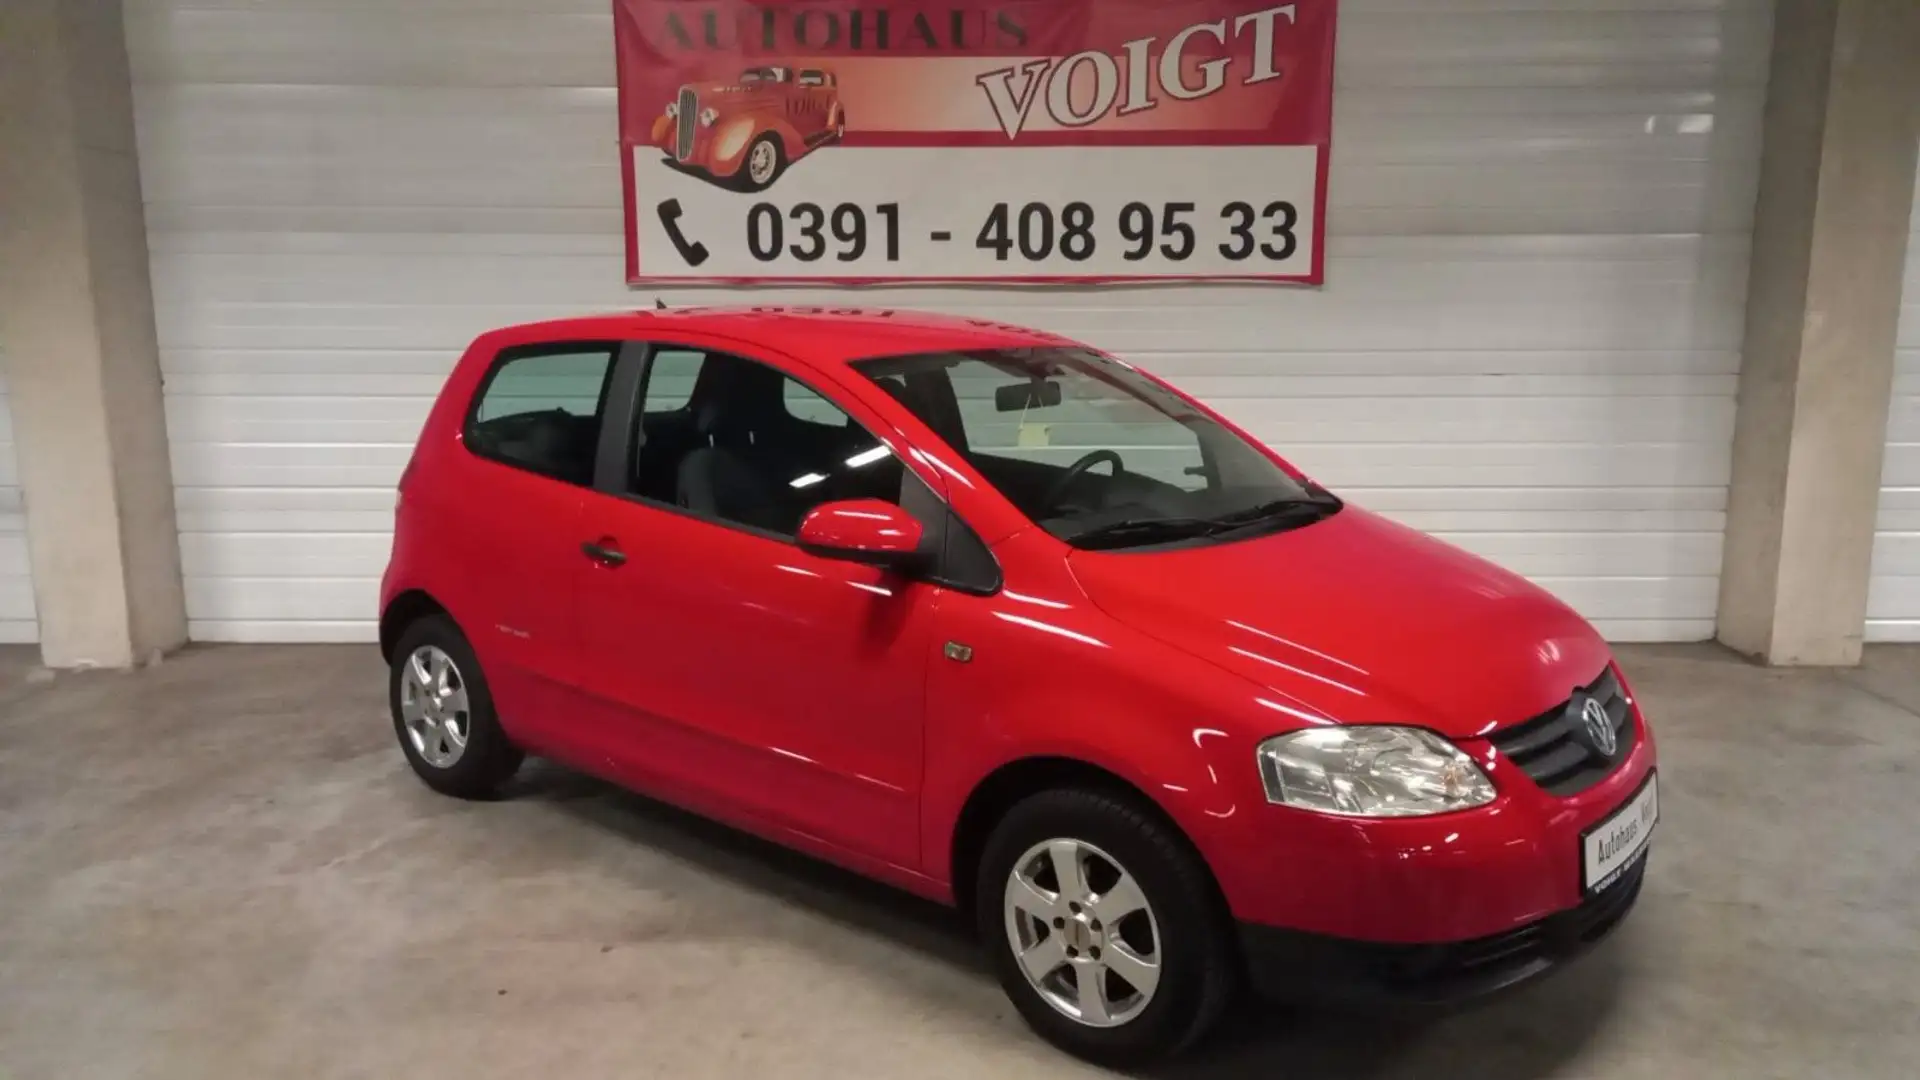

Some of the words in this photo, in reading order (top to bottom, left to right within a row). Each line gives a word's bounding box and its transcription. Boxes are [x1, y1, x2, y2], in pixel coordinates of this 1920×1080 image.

[659, 8, 1027, 50] AUTOHAUS
[975, 3, 1297, 140] VOIGT
[747, 202, 899, 262] 0391
[930, 231, 951, 241] -
[975, 201, 1096, 262] 408
[1118, 201, 1196, 261] 95
[1218, 200, 1298, 261] 33
[1598, 818, 1637, 865] Autohaus
